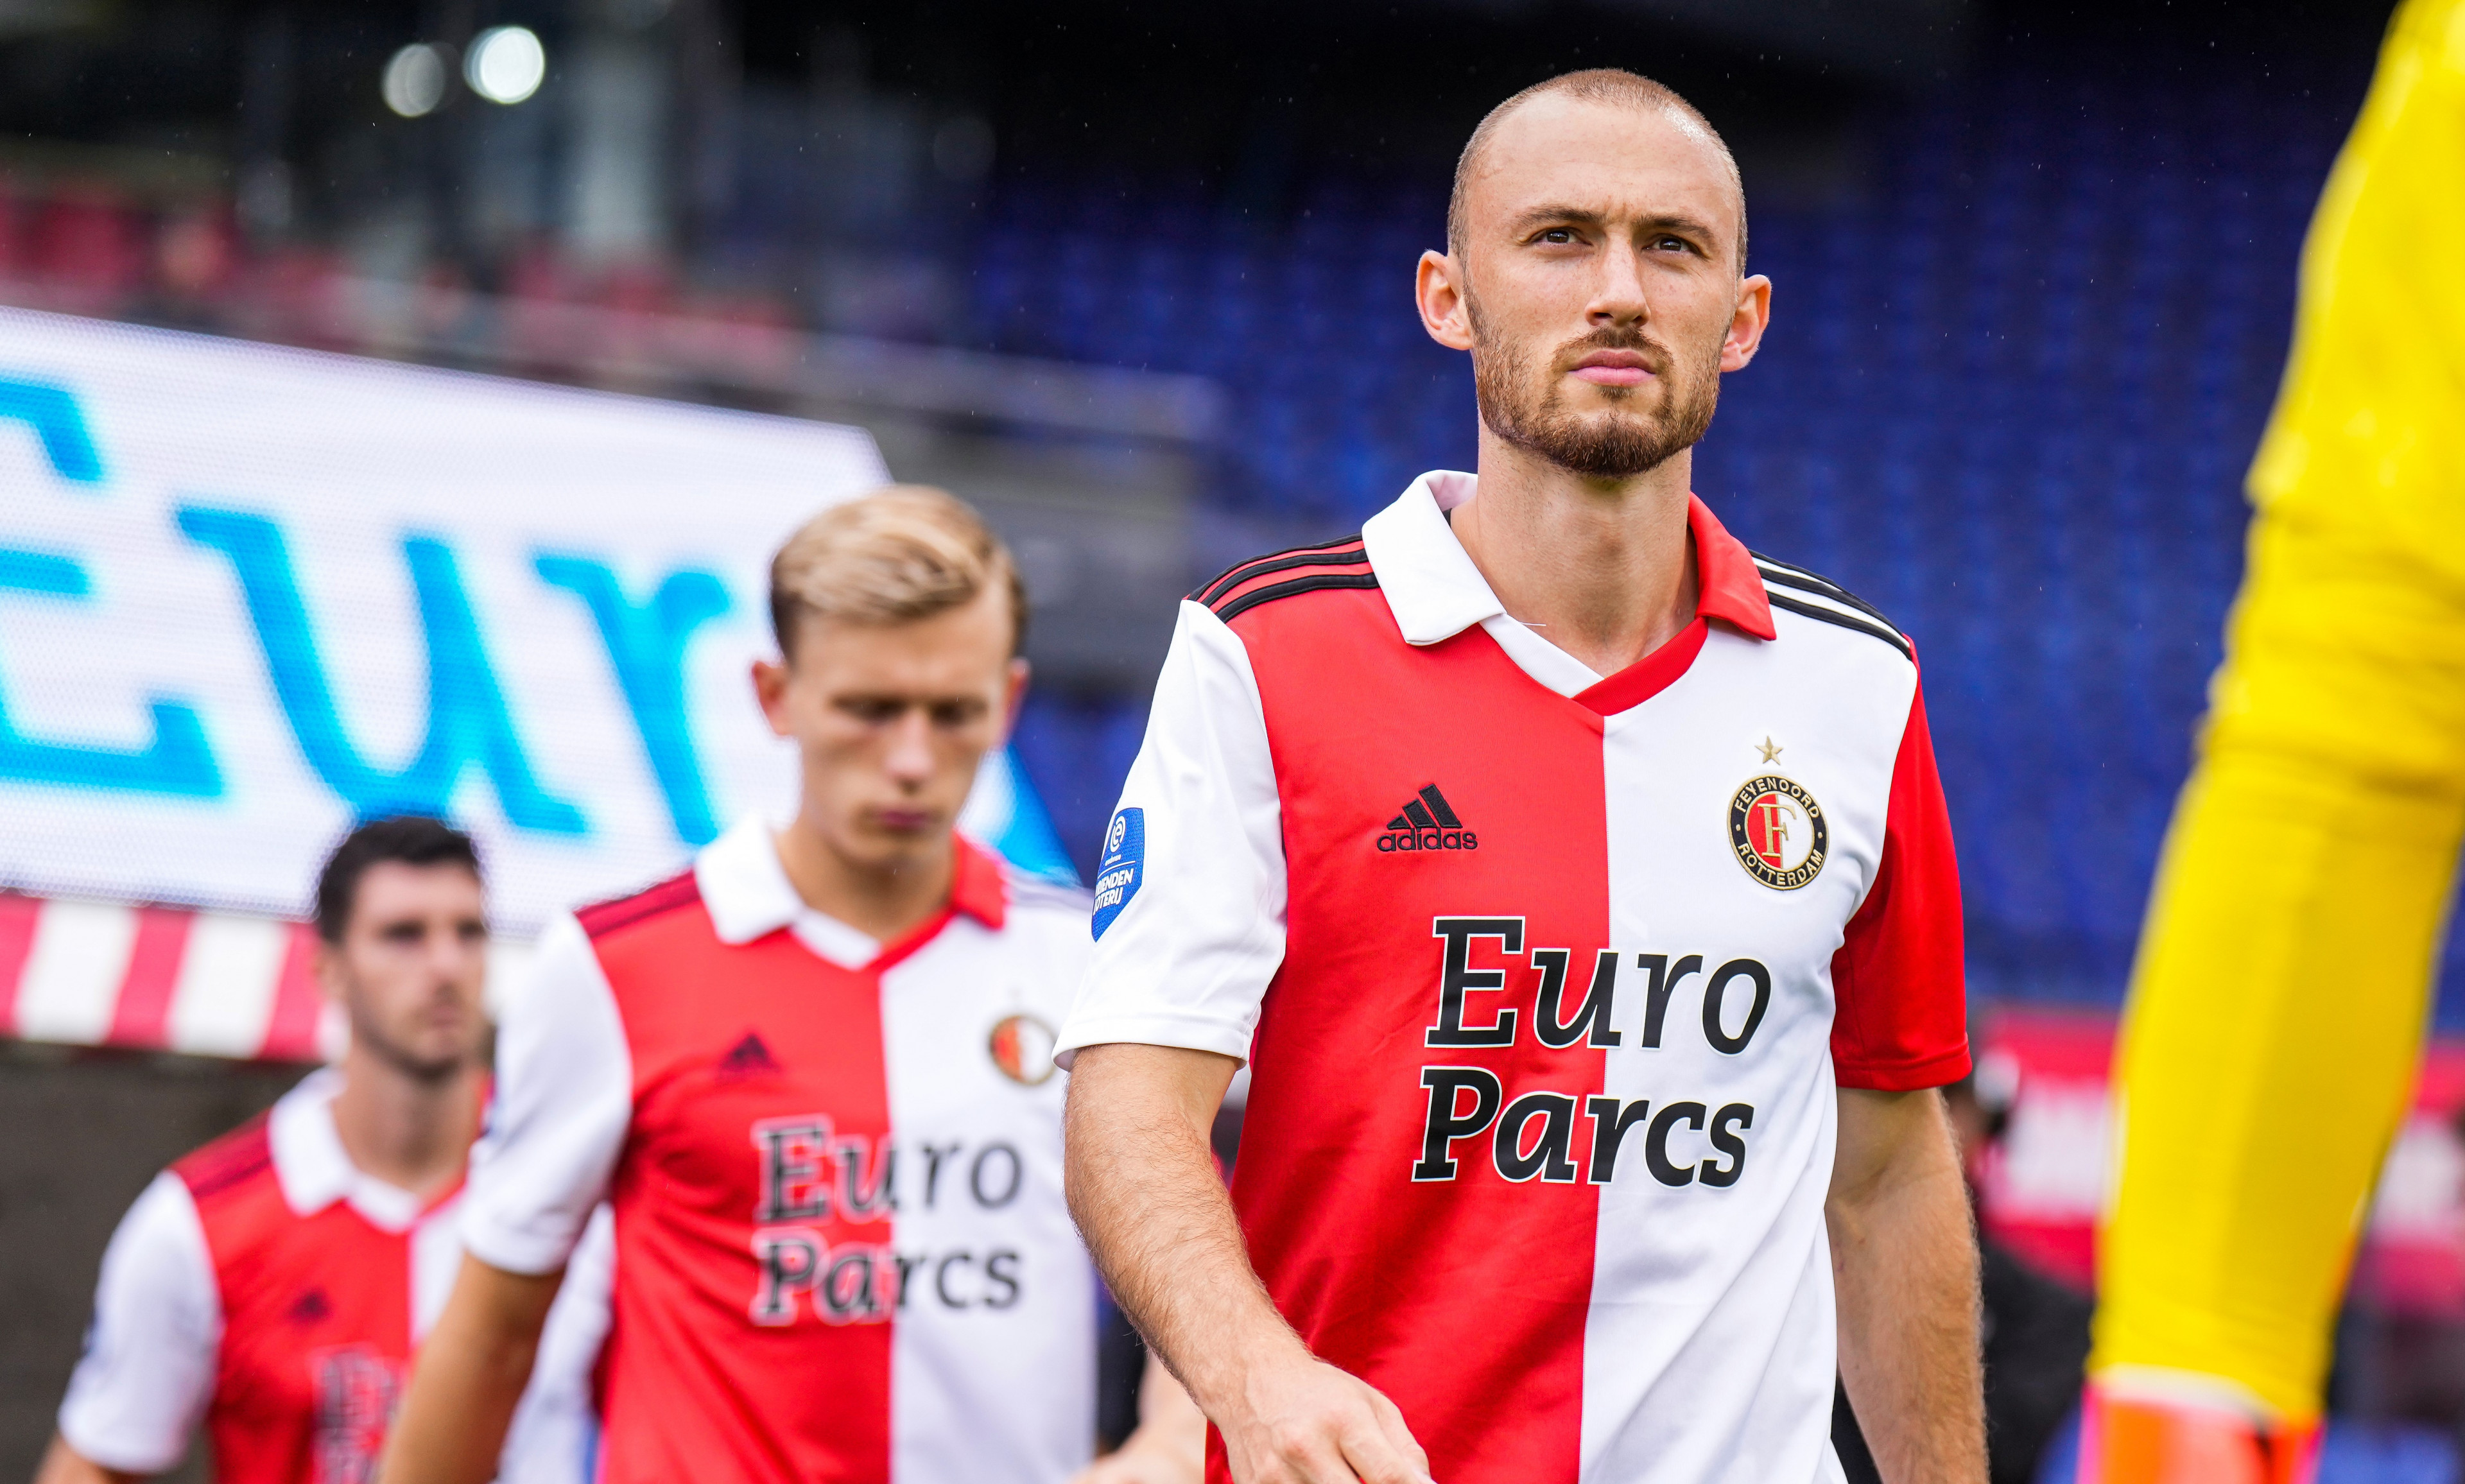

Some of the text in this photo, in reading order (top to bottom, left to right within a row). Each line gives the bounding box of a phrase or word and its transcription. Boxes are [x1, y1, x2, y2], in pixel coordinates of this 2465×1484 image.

[1734, 777, 1820, 818] FEYENOORD
[1758, 802, 1797, 858] F
[1376, 826, 1478, 852] adidas
[1737, 842, 1824, 886] ROTTERDAM
[1424, 915, 1772, 1057] Euro
[1410, 1065, 1756, 1191] Parcs
[751, 1114, 1026, 1225] Euro
[750, 1228, 1023, 1327] Parcs
